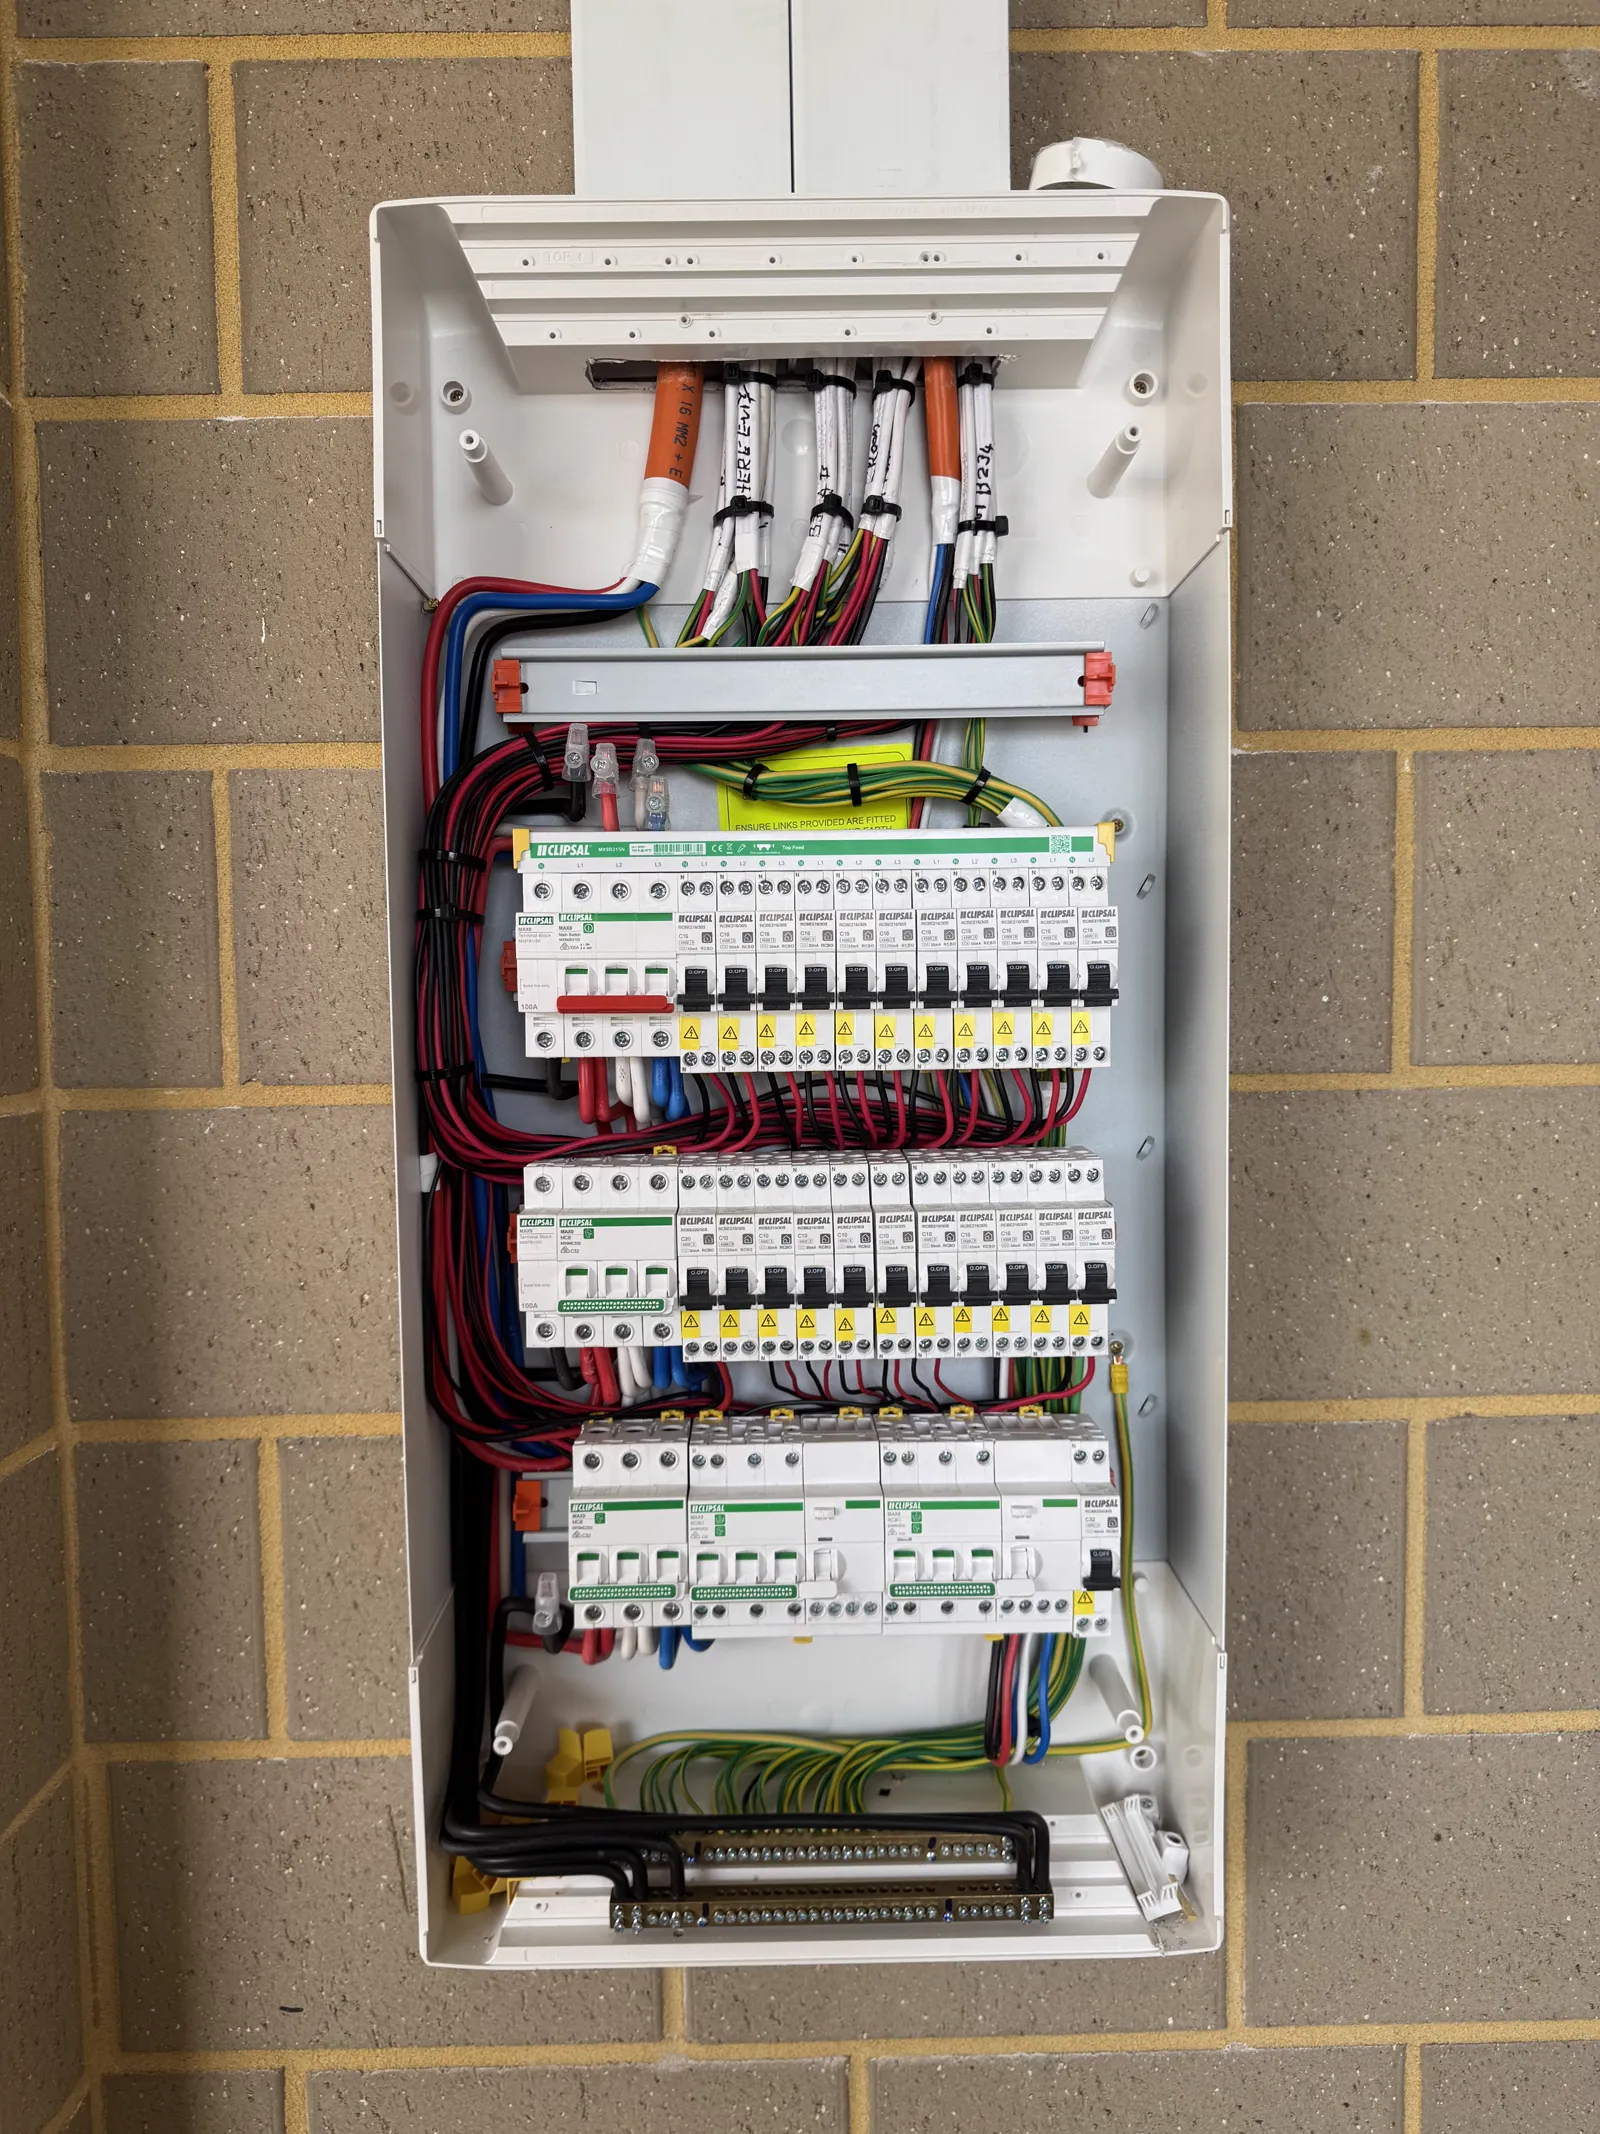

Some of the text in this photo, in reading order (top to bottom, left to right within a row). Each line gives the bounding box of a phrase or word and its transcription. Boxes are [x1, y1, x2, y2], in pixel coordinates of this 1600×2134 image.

[681, 383, 695, 394] X
[679, 401, 693, 415] 16
[674, 421, 690, 447] MM2
[669, 467, 683, 478] E
[735, 822, 771, 831] ENSURE
[773, 821, 798, 829] LINKS
[800, 818, 845, 828] PROVIDED
[846, 817, 864, 825] ARE
[866, 815, 897, 824] FITTED
[537, 844, 590, 856] CLIPSAL
[799, 913, 833, 921] CLIPSAL
[840, 912, 873, 920] CLIPSAL
[879, 912, 913, 920] CLIPSAL
[921, 912, 955, 920] CLIPSAL
[961, 911, 994, 919] CLIPSAL
[1000, 910, 1034, 918] CLIPSAL
[1041, 909, 1074, 918] CLIPSAL
[1082, 909, 1116, 917] CLIPSAL
[520, 917, 553, 925] CLIPSAL
[760, 914, 793, 922] CLIPSAL
[880, 1215, 913, 1223] CLIPSAL
[922, 1215, 955, 1223] CLIPSAL
[960, 1214, 993, 1222] CLIPSAL
[1000, 1213, 1033, 1221] CLIPSAL
[1039, 1212, 1073, 1220] CLIPSAL
[1078, 1211, 1112, 1220] CLIPSAL
[561, 1219, 593, 1227] CLIPSAL
[680, 1217, 713, 1225] CLIPSAL
[720, 1217, 753, 1225] CLIPSAL
[759, 1217, 792, 1225] CLIPSAL
[797, 1217, 830, 1225] CLIPSAL
[837, 1216, 871, 1224] CLIPSAL
[572, 1503, 604, 1511] CLIPSAL
[888, 1501, 921, 1509] CLIPSAL
[1085, 1499, 1118, 1507] CLIPSAL
[692, 1504, 725, 1512] CLIPSAL
